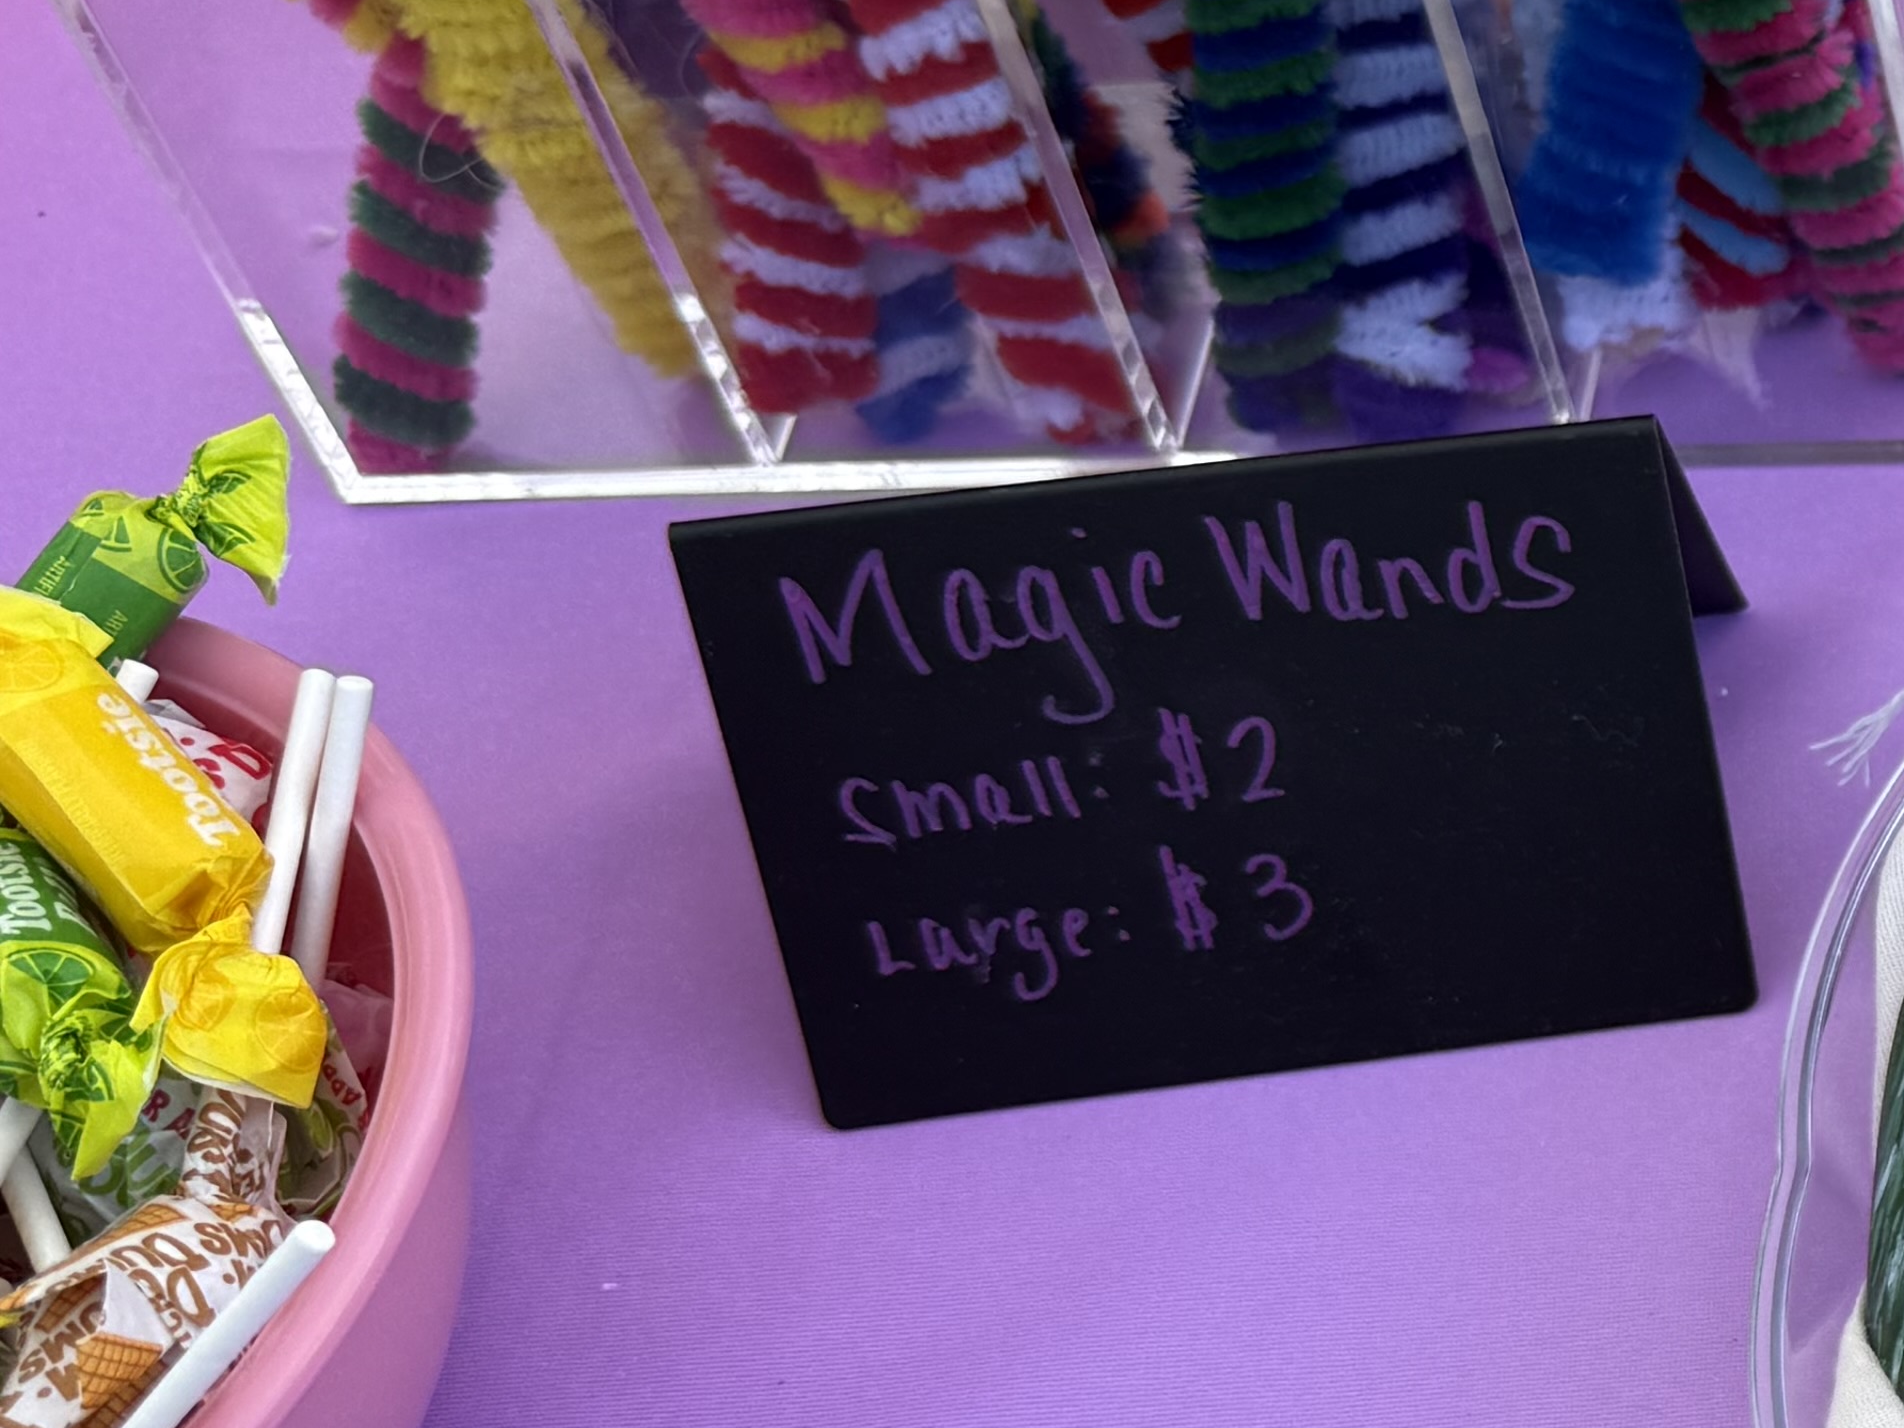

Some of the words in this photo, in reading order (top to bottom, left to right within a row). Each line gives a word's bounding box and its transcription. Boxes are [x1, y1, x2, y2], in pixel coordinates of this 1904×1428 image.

[780, 529, 1180, 725] Magic
[1204, 501, 1574, 624] Wands
[97, 691, 241, 847] Tootsie
